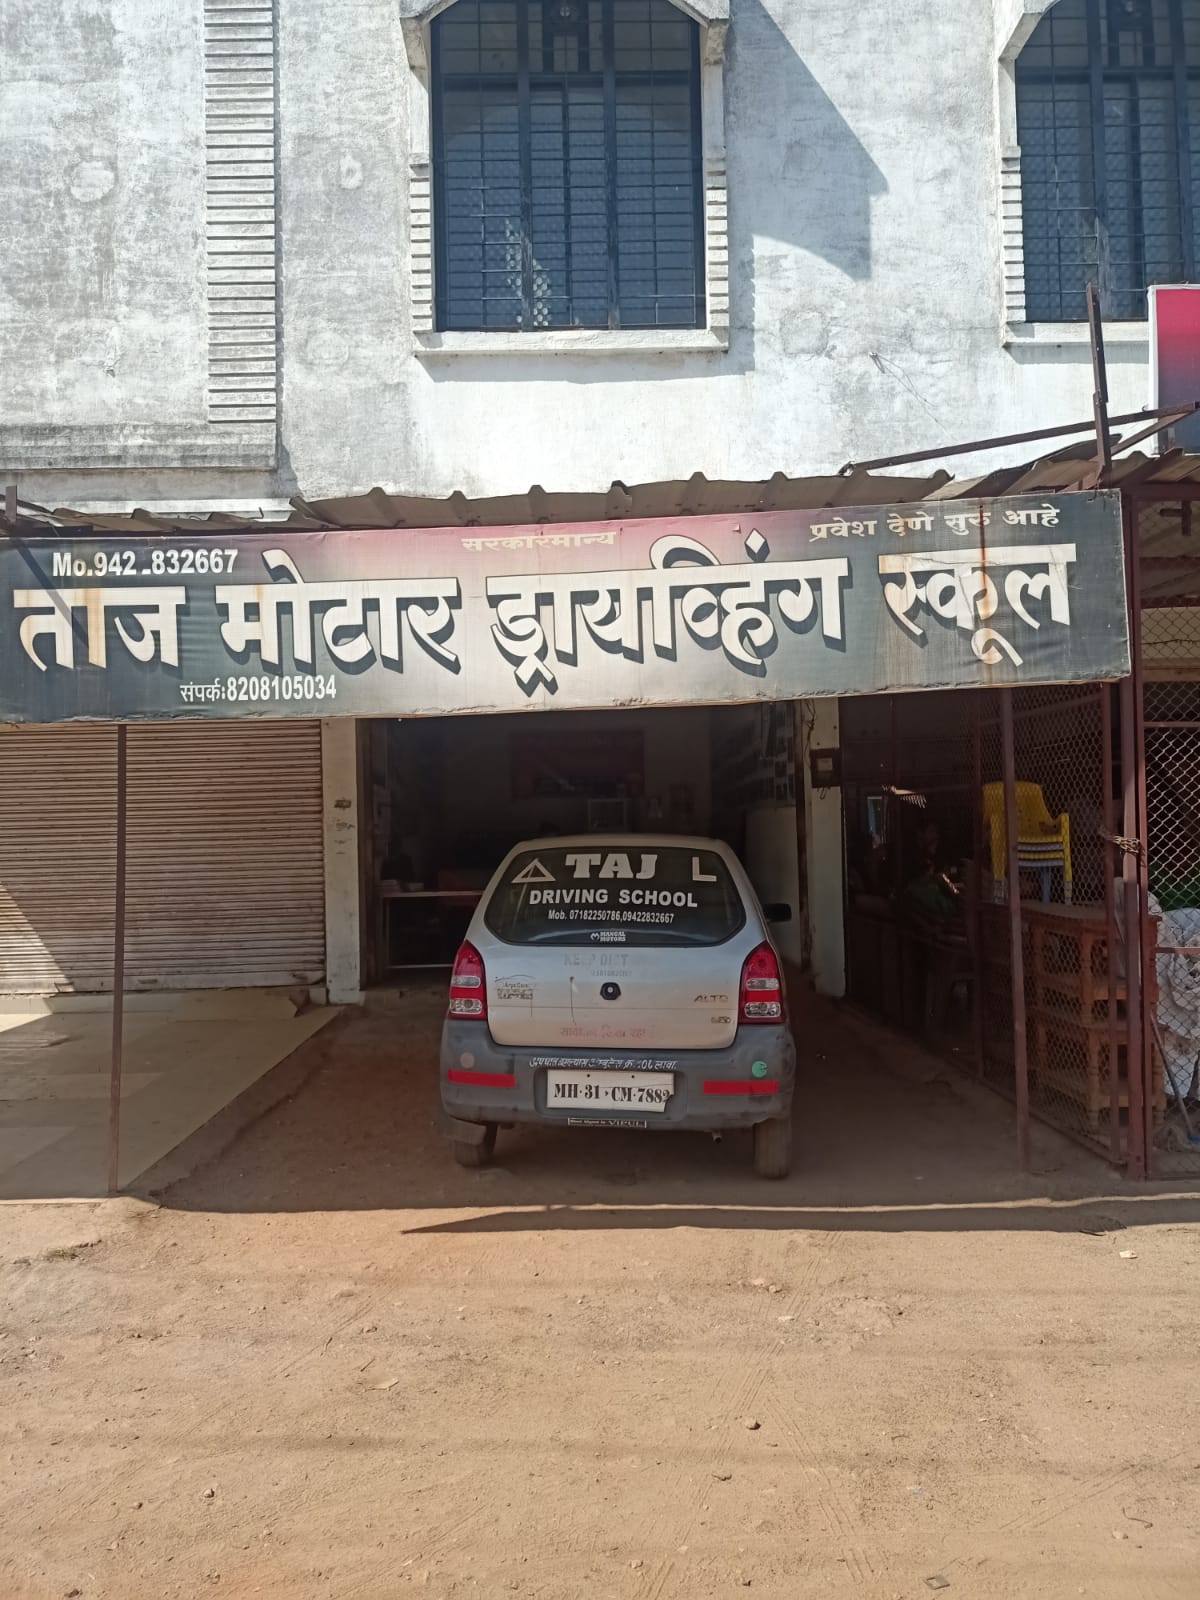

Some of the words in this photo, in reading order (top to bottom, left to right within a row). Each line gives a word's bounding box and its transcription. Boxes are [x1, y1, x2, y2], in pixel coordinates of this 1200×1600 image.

[809, 517, 877, 542] प्रवेश
[887, 512, 934, 536] देणे
[1002, 504, 1060, 528] आहे
[461, 531, 617, 551] सरकारमान्य
[52, 548, 239, 577] Mo.942832667
[14, 586, 188, 673] ताज
[216, 549, 462, 674] मोटार
[486, 528, 850, 692] ड्रायव्हिंग
[878, 543, 1077, 667] स्कूल
[565, 852, 658, 880] TAJ
[691, 856, 717, 882] L
[529, 888, 608, 905] DRIVING
[619, 889, 698, 908] SCHOOL
[548, 909, 567, 920] Mob.
